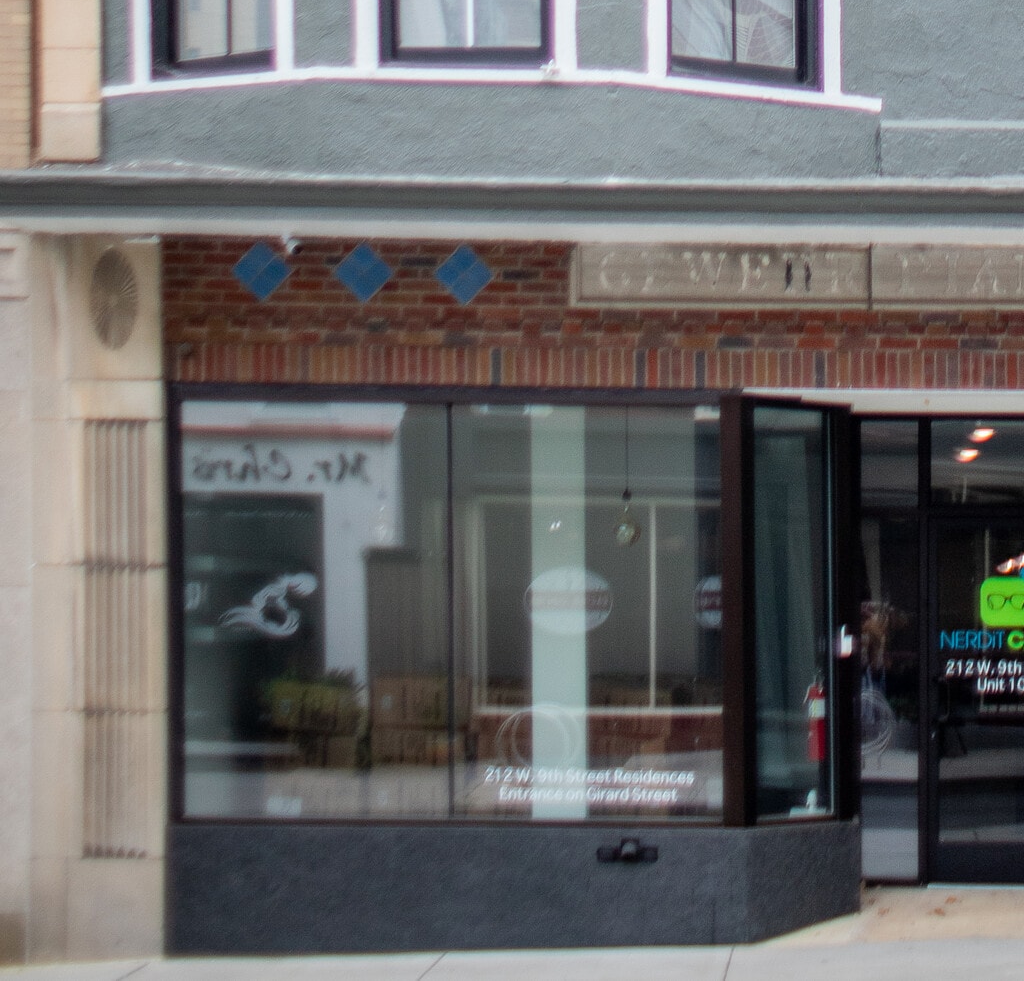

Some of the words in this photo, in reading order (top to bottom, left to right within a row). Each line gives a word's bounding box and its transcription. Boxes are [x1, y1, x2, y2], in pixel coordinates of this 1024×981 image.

[944, 659, 974, 676] 212
[997, 658, 1022, 676] 9th
[976, 677, 1005, 692] Unit
[484, 766, 513, 784] 212
[537, 767, 563, 784] 9th
[565, 768, 612, 785] Street
[613, 768, 696, 786] Residences
[499, 785, 565, 802] Entrance
[566, 789, 585, 802] on
[586, 786, 630, 804] Girard
[631, 787, 680, 804] Street
